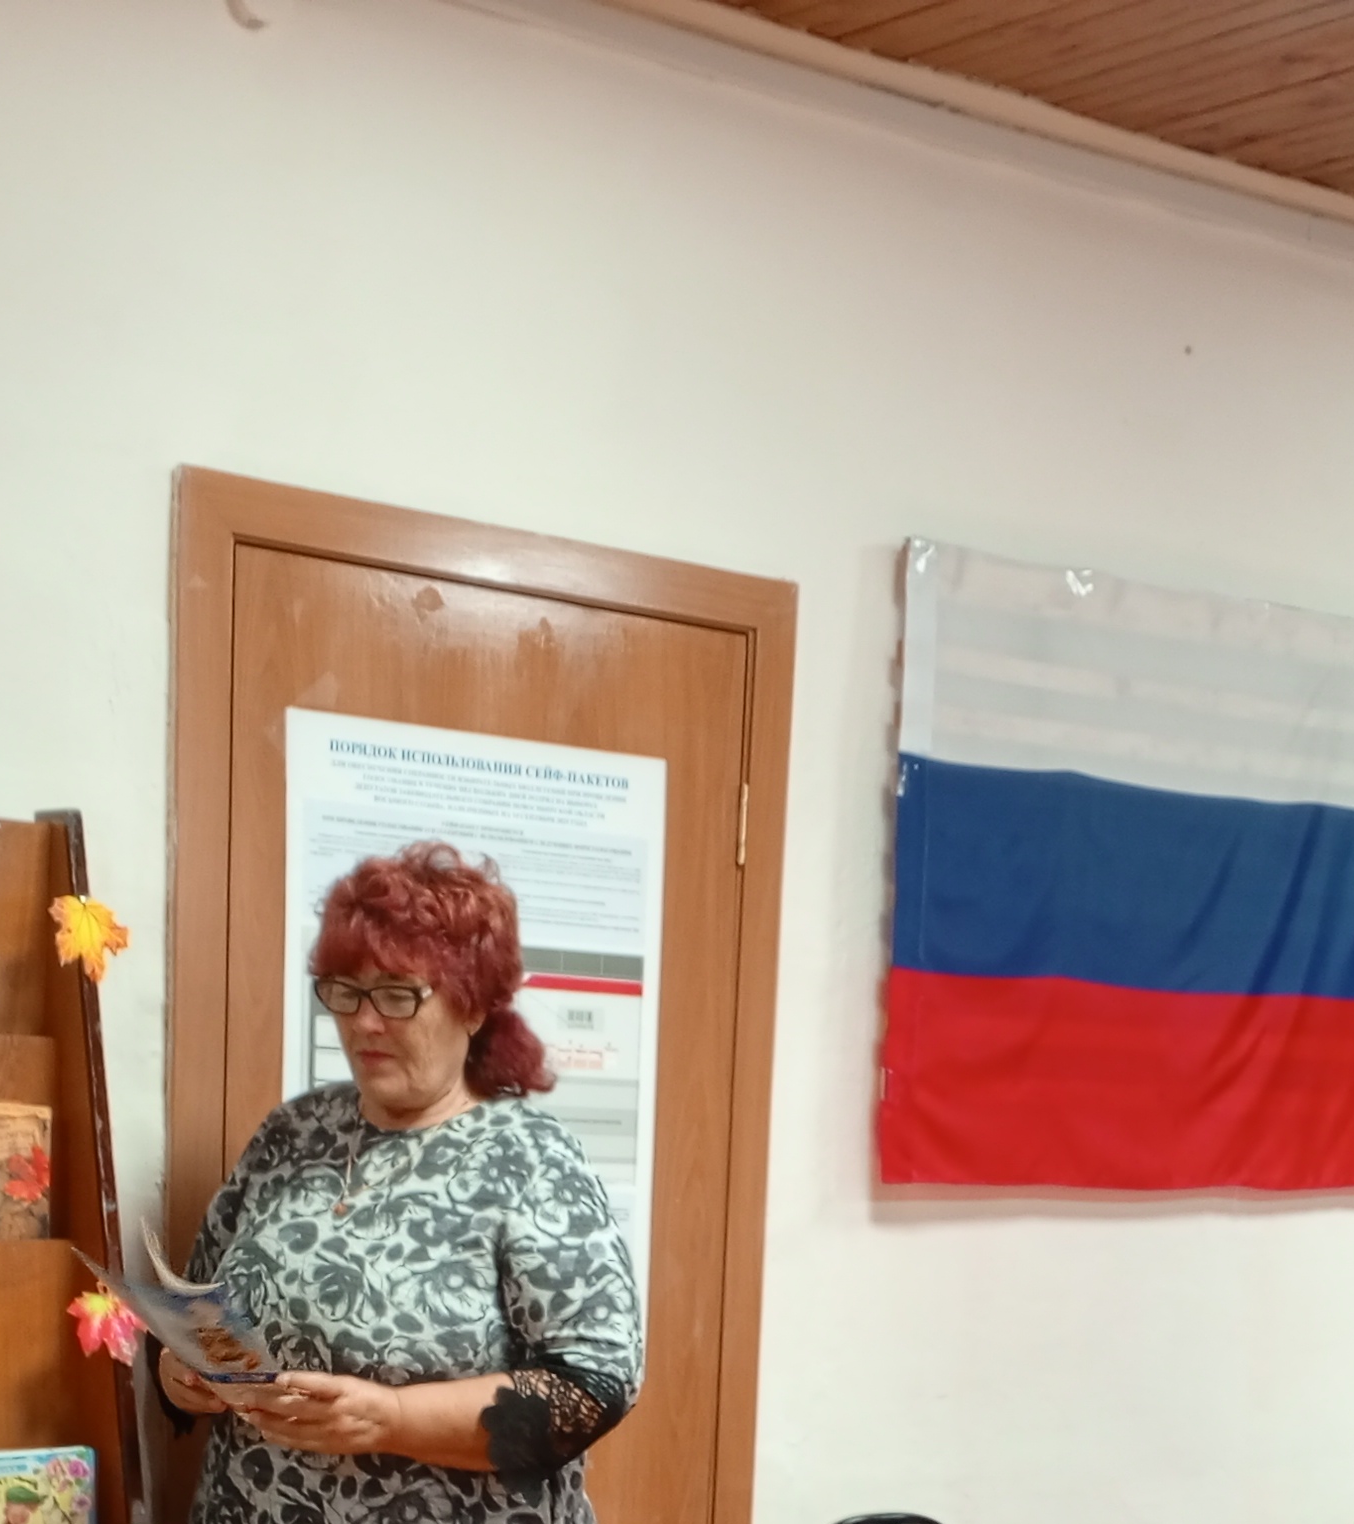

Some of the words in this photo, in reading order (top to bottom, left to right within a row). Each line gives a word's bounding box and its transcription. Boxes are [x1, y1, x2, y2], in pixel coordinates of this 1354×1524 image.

[329, 739, 397, 759] ПОРЯДОК
[401, 747, 523, 776] ИСПОЛЬЗОВАНИЯ
[526, 765, 630, 790] СЕЙФ-ПАКЕТОВ
